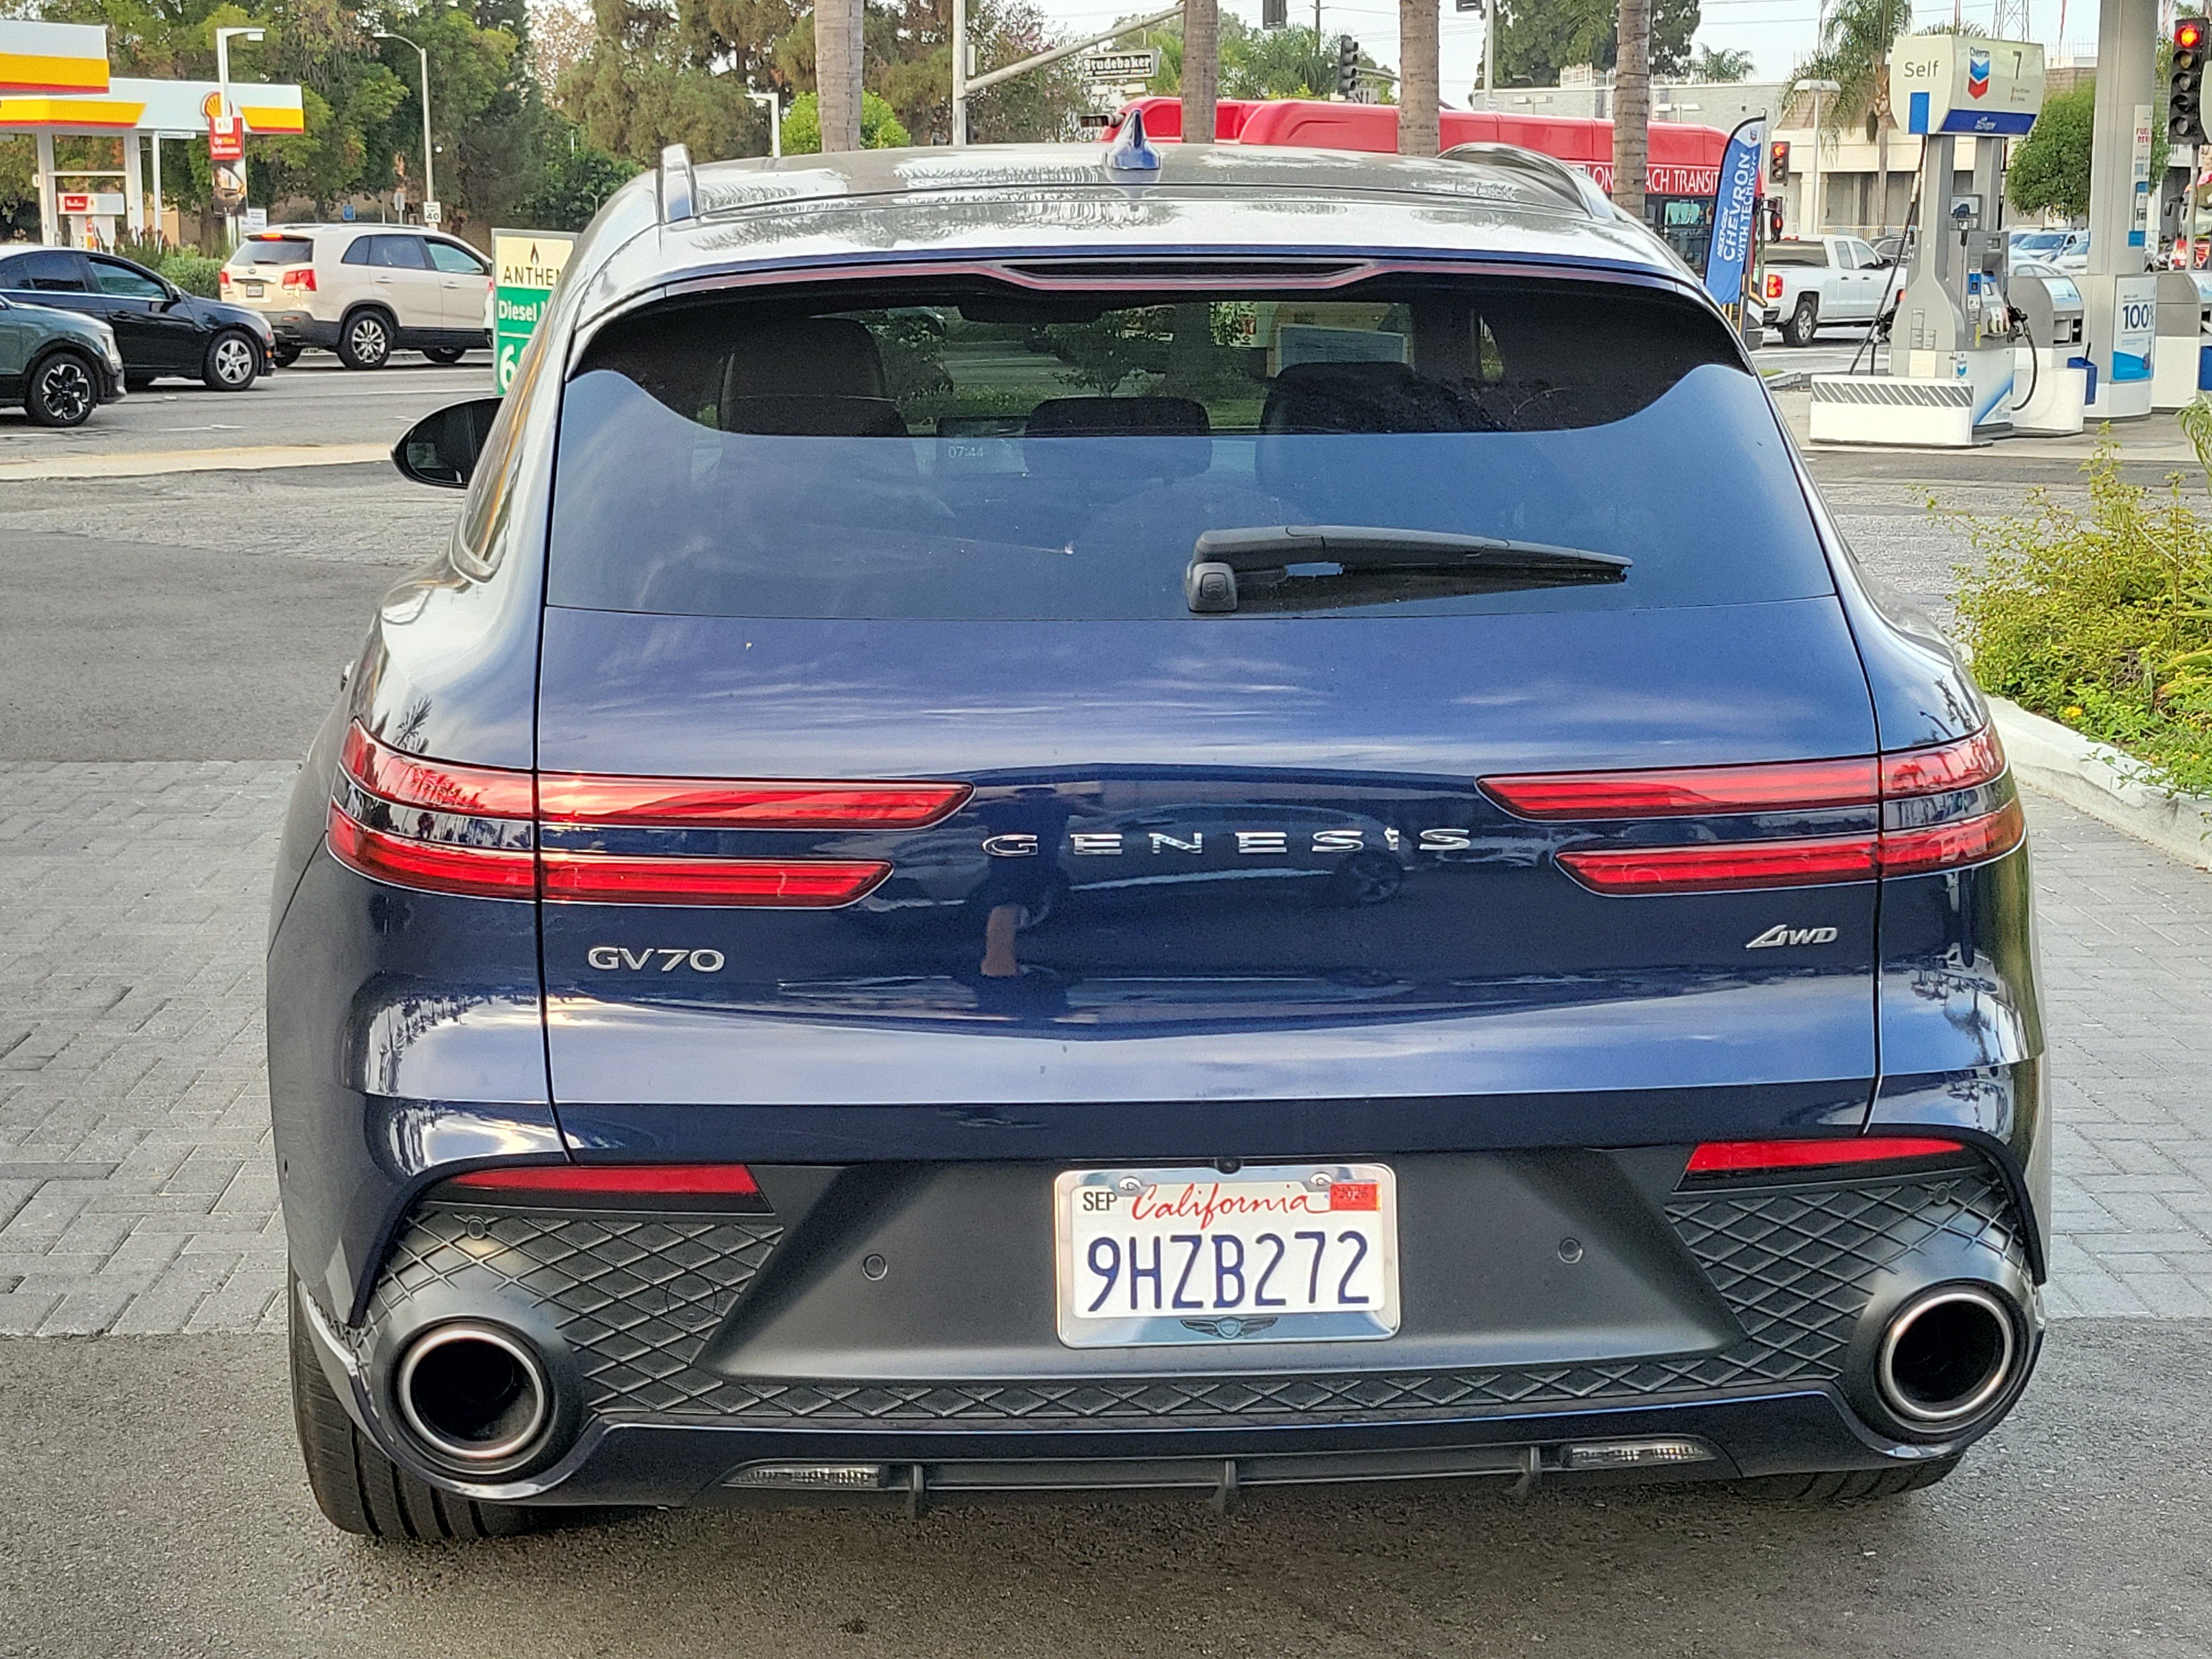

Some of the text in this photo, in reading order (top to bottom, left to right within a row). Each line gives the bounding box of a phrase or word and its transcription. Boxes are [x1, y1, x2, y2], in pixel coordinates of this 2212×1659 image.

[1083, 57, 1151, 71] Studebaker
[1904, 60, 1939, 77] Self
[2012, 50, 2022, 80] 7
[1645, 168, 1669, 192] ACH
[1674, 169, 1720, 193] TRANSIT
[1723, 153, 1750, 261] CHEVRON
[1737, 225, 1749, 263] WITH
[503, 266, 560, 286] ANTHE
[499, 300, 537, 322] Diesel
[948, 446, 984, 458] 07:44
[983, 829, 1471, 855] GENESIS
[1746, 924, 1838, 949] 4WD
[588, 947, 725, 972] GV70
[1082, 1192, 1117, 1211] SEP
[1132, 1183, 1330, 1229] California
[1087, 1231, 1369, 1312] 9HZB272
